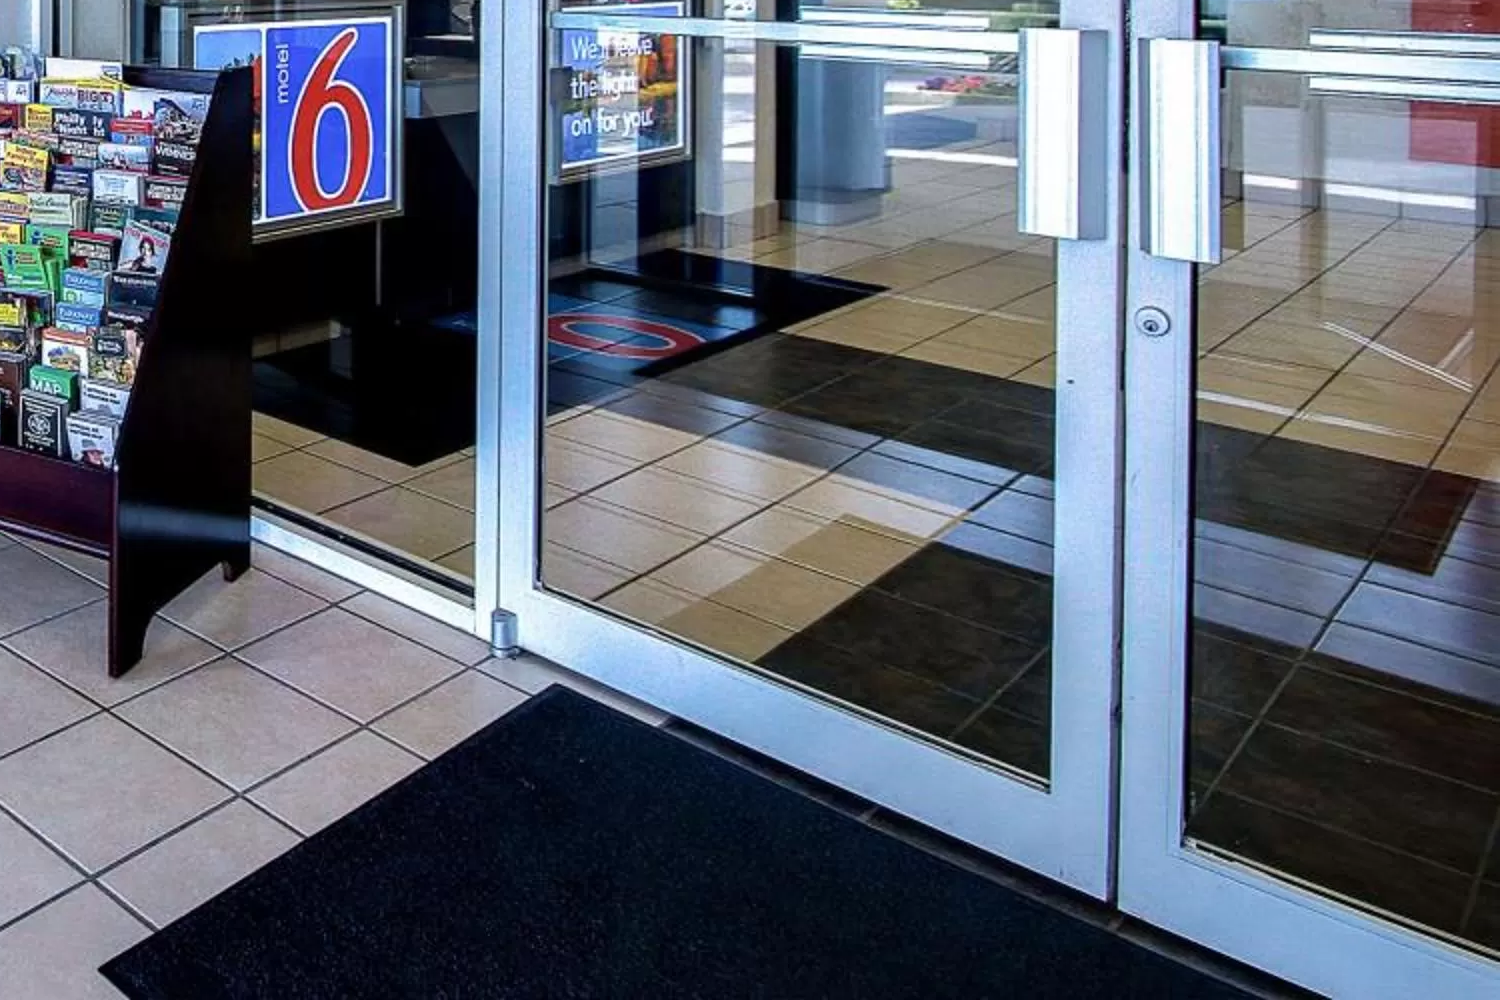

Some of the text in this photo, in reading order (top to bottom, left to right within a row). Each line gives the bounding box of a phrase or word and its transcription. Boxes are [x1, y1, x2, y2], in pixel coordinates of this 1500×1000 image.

[275, 43, 289, 104] motel
[570, 73, 598, 99] the
[287, 27, 374, 213] 6
[571, 116, 593, 136] on
[598, 107, 620, 133] for
[29, 378, 62, 395] MAP
